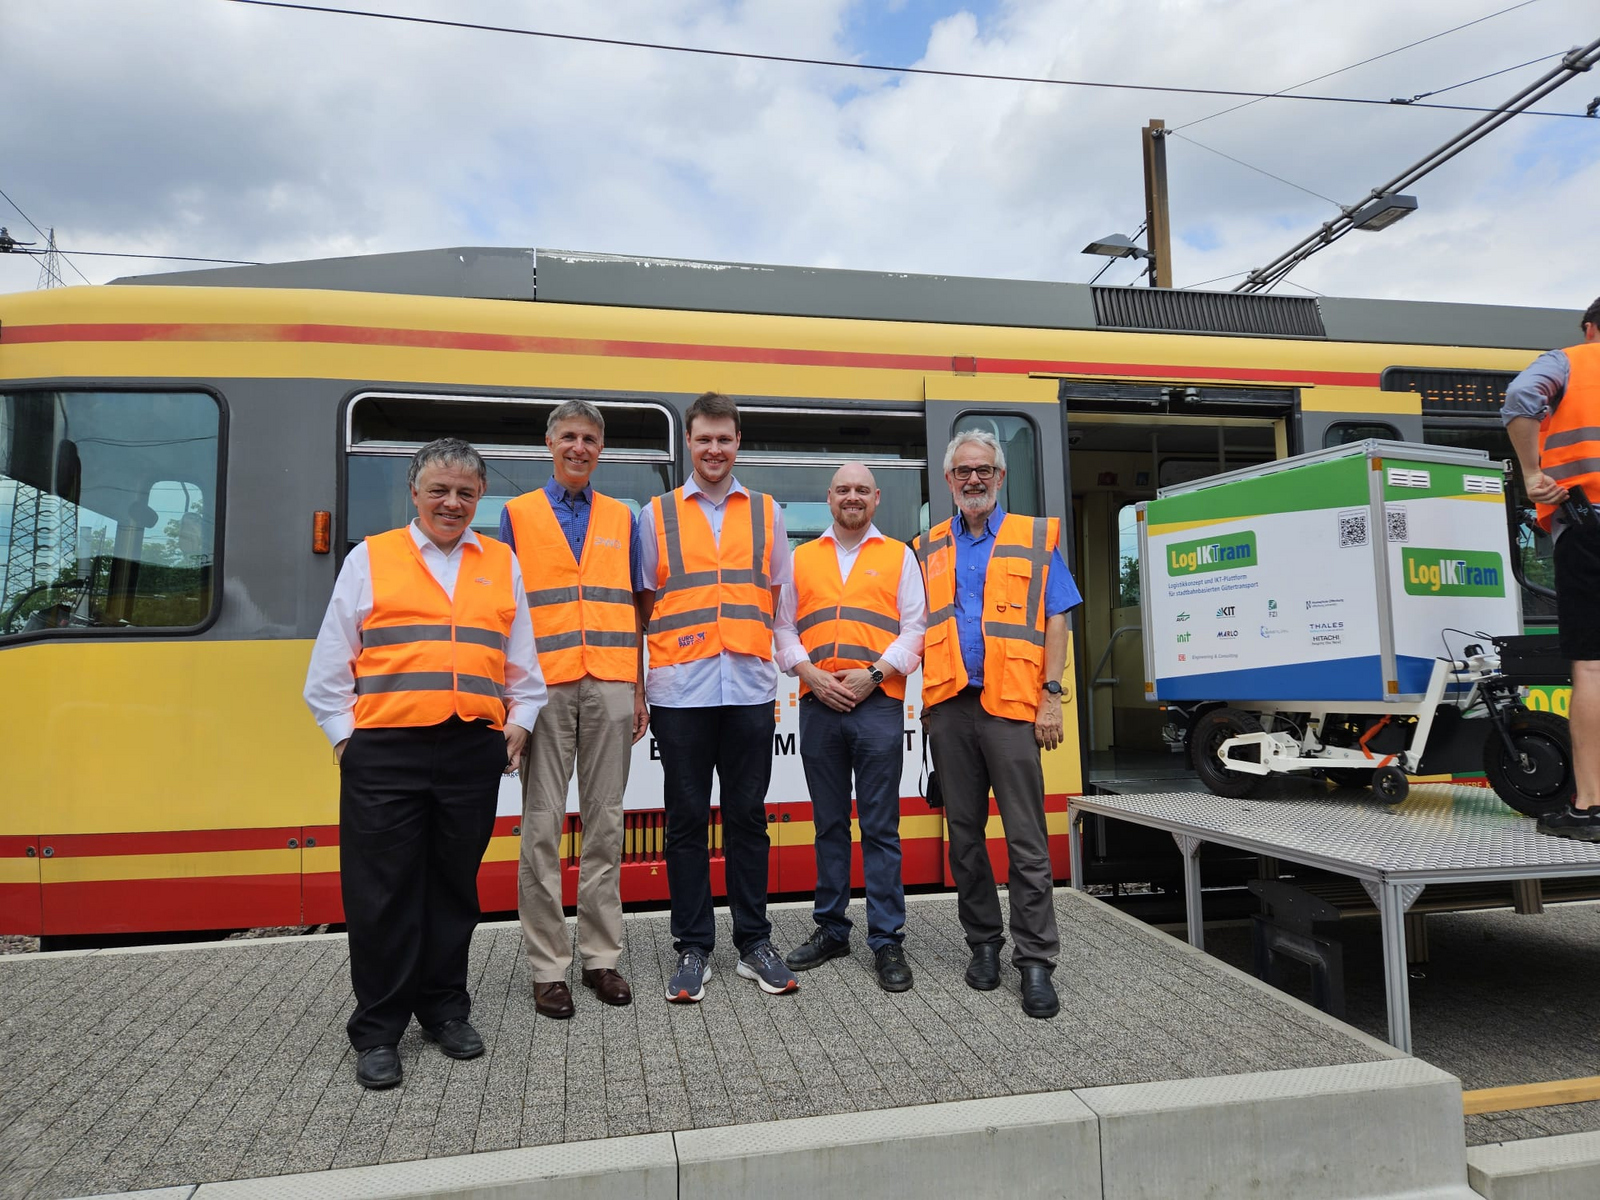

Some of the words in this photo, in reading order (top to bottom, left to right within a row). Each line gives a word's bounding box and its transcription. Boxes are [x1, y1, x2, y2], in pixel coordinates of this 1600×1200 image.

[1171, 541, 1251, 571] LogIKTram
[1408, 557, 1498, 592] LogIKTram
[1168, 579, 1204, 589] Logistikkonzept
[1214, 574, 1248, 583] IKT-Plattform
[1176, 586, 1220, 597] stadtbahnbasierten
[1221, 582, 1259, 592] Gütertransport
[1222, 606, 1236, 616] KIT
[678, 634, 694, 642] EURO
[1177, 631, 1191, 643] init
[1217, 630, 1239, 638] MARLO
[679, 639, 694, 647] PART
